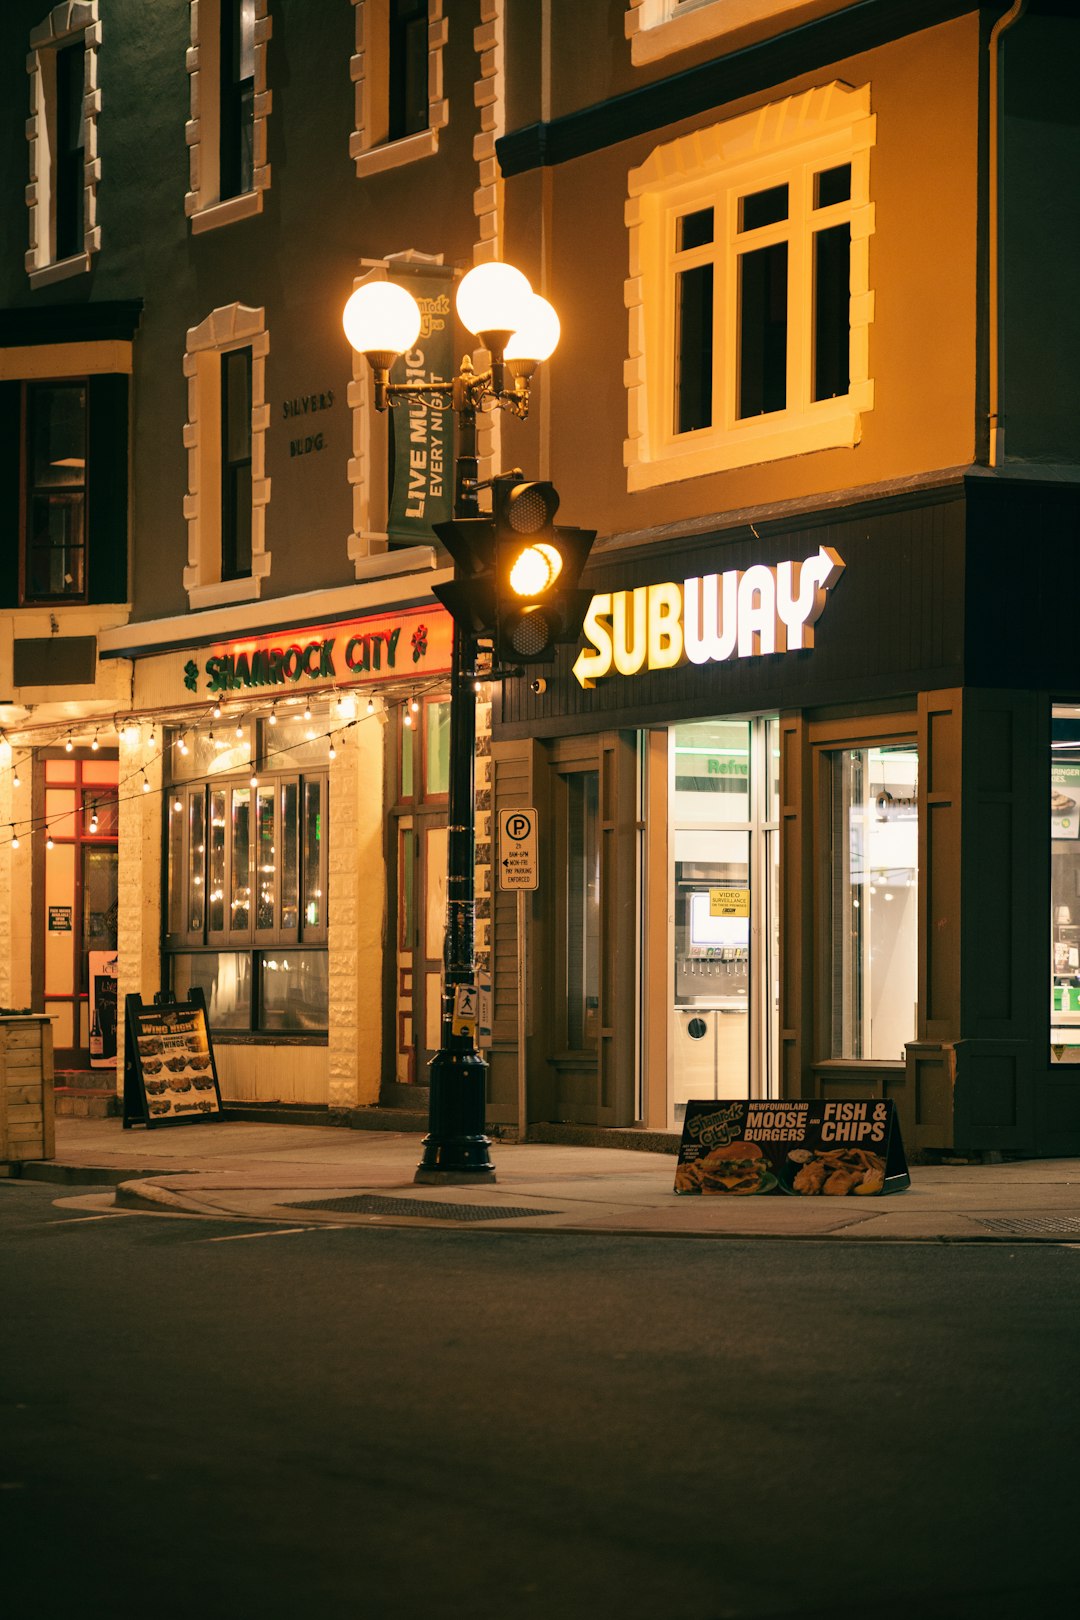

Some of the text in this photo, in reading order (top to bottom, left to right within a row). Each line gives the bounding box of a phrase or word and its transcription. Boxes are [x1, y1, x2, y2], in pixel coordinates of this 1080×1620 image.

[283, 390, 334, 419] SILVERS
[430, 436, 443, 496] EVERY
[405, 450, 426, 518] LIVE
[572, 545, 846, 689] SUBWAY
[205, 627, 401, 691] SHAMROCK CITY
[513, 819, 525, 835] P
[142, 1023, 168, 1034] WING
[163, 1040, 185, 1049] WINGS
[748, 1103, 809, 1111] NEWFOUNDLAND
[824, 1103, 888, 1121] FISH &
[746, 1112, 807, 1129] MOOSE
[743, 1128, 805, 1142] BURGERS
[820, 1122, 885, 1142] CHIPS
